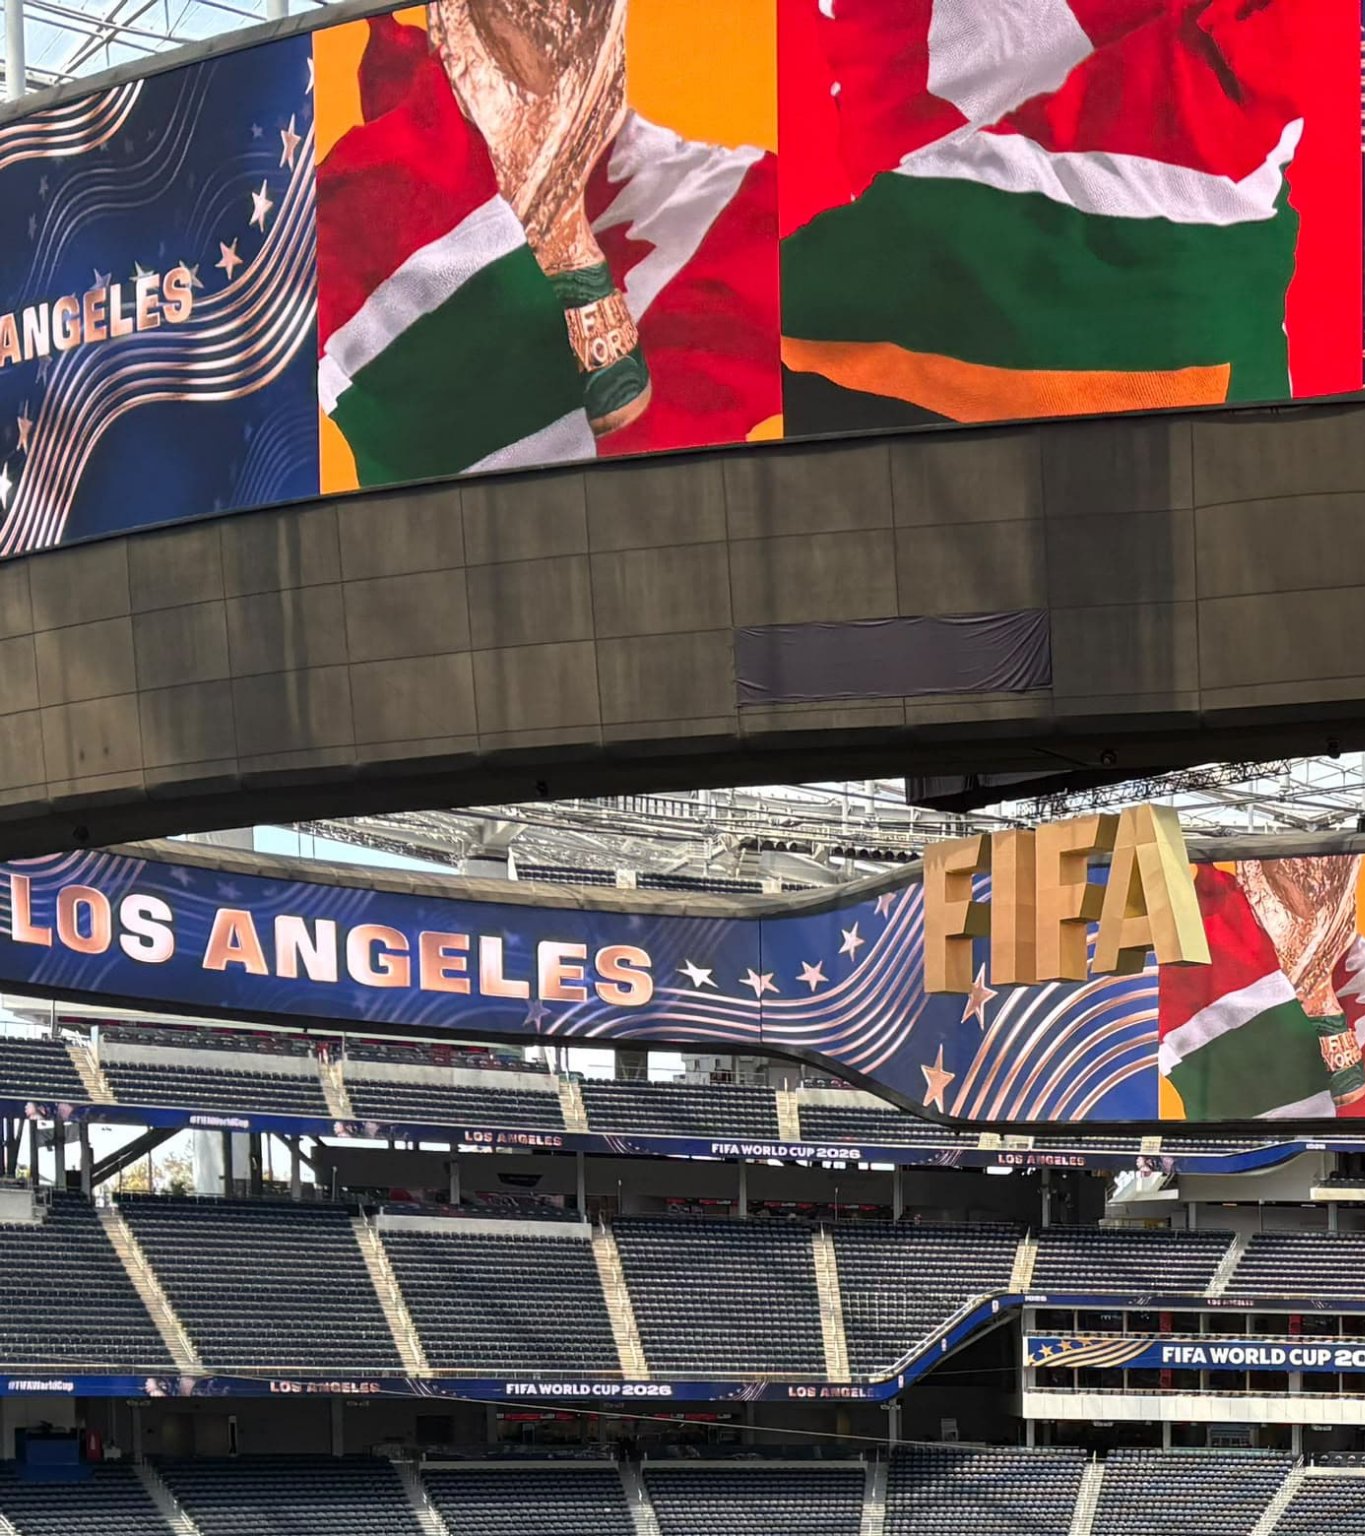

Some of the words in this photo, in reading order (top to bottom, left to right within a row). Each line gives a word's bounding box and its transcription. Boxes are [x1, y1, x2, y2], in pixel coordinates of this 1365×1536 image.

[0, 266, 193, 368] ANGELES
[923, 802, 1211, 993] FIFA
[11, 874, 174, 964] LOS
[203, 907, 654, 1005] ANGELES
[465, 1131, 492, 1143] LOS
[498, 1133, 562, 1146] ANGELES
[712, 1143, 739, 1154] FIFA
[741, 1145, 787, 1156] WORLD
[790, 1146, 815, 1157] CUP
[816, 1148, 861, 1159] 2026
[999, 1154, 1023, 1165] LOS
[1027, 1154, 1085, 1166] ANGELES
[1162, 1346, 1207, 1364] FIFA
[1209, 1347, 1286, 1365] WORLD
[1289, 1349, 1331, 1366] CUP
[270, 1382, 302, 1393] LOS
[306, 1382, 380, 1393] ANGELES
[506, 1383, 537, 1395] FIFA
[539, 1384, 590, 1395] WORLD
[592, 1384, 620, 1396] CUP
[622, 1385, 672, 1396] 2026
